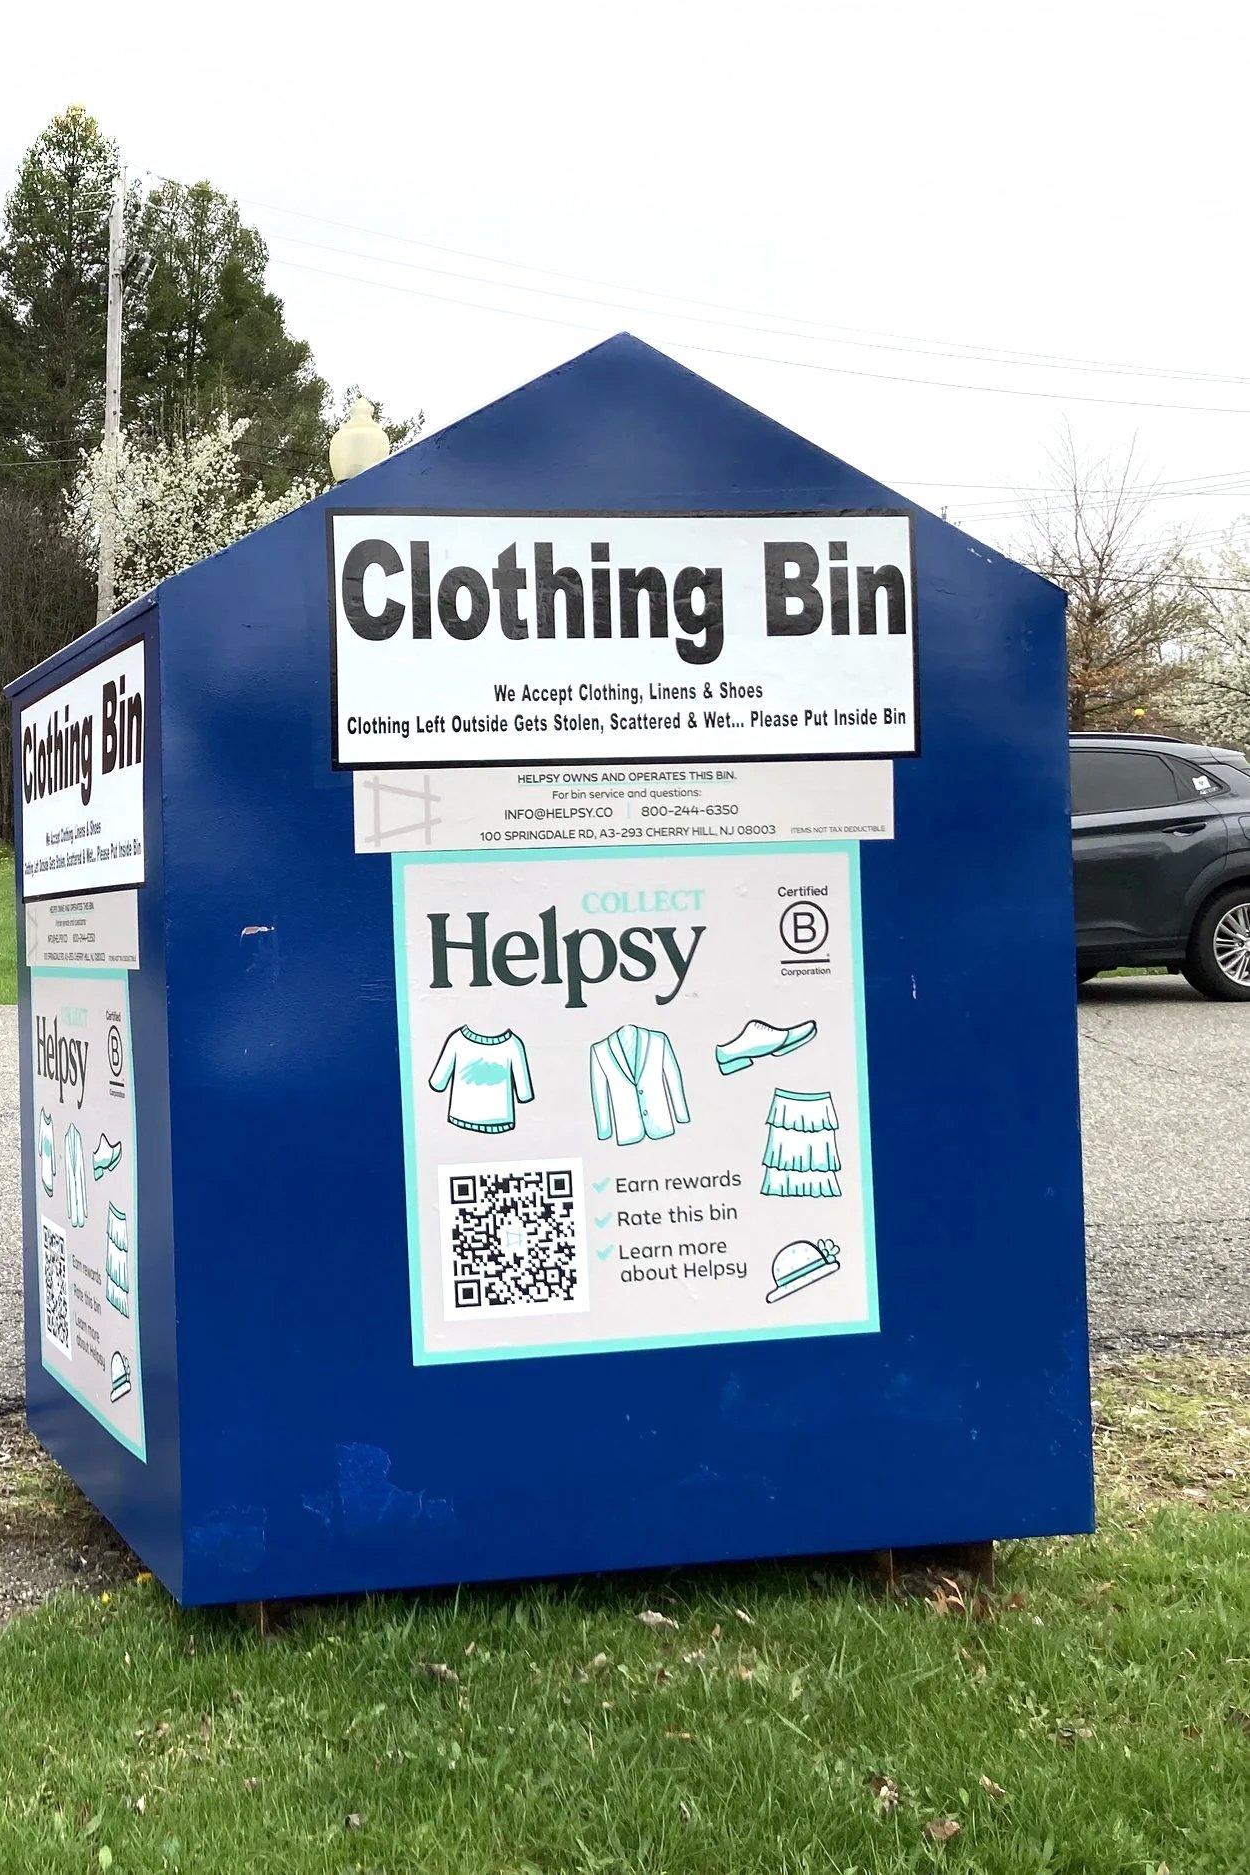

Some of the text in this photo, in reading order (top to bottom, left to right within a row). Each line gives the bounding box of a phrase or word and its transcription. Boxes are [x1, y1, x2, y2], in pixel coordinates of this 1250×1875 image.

[342, 539, 907, 665] Clothing Bin
[494, 681, 763, 705] We Accept Clothing, Linens & Shoes
[347, 708, 906, 738] Clothing Left Outside Gets Stolen, Scattered & Wet... Please Put Inside Bin
[23, 674, 143, 806] Clothing Bin
[517, 771, 737, 784] HELPSY OWNS AND OPERATES THIS BIN.
[552, 788, 702, 800] For bin service and questions:
[504, 804, 739, 820] INFO@HELPSY.CO 800-244-6350
[480, 831, 501, 841] 100
[504, 830, 576, 841] SPRINGDALE
[578, 829, 597, 840] RD,
[599, 828, 643, 839] A3-293
[645, 827, 690, 837] CHERRY
[692, 826, 718, 837] HILL,
[720, 825, 735, 835] NJ
[737, 825, 776, 835] 08003
[844, 825, 886, 833] DEDUCTIBLE
[581, 888, 706, 914] COLLECT
[777, 885, 828, 897] Certified
[793, 912, 817, 943] B
[427, 905, 707, 1009] Helpsy
[781, 967, 831, 977] Corporation
[36, 1014, 89, 1110] Helpsy
[616, 1170, 741, 1193] Earn rewards
[617, 1203, 738, 1226] Rate this bin
[619, 1241, 727, 1260] Learn more
[72, 1254, 102, 1285] Earn rewards
[621, 1259, 748, 1282] about Helpsy
[74, 1283, 102, 1316] Rate this bin
[75, 1311, 100, 1343] Learn more
